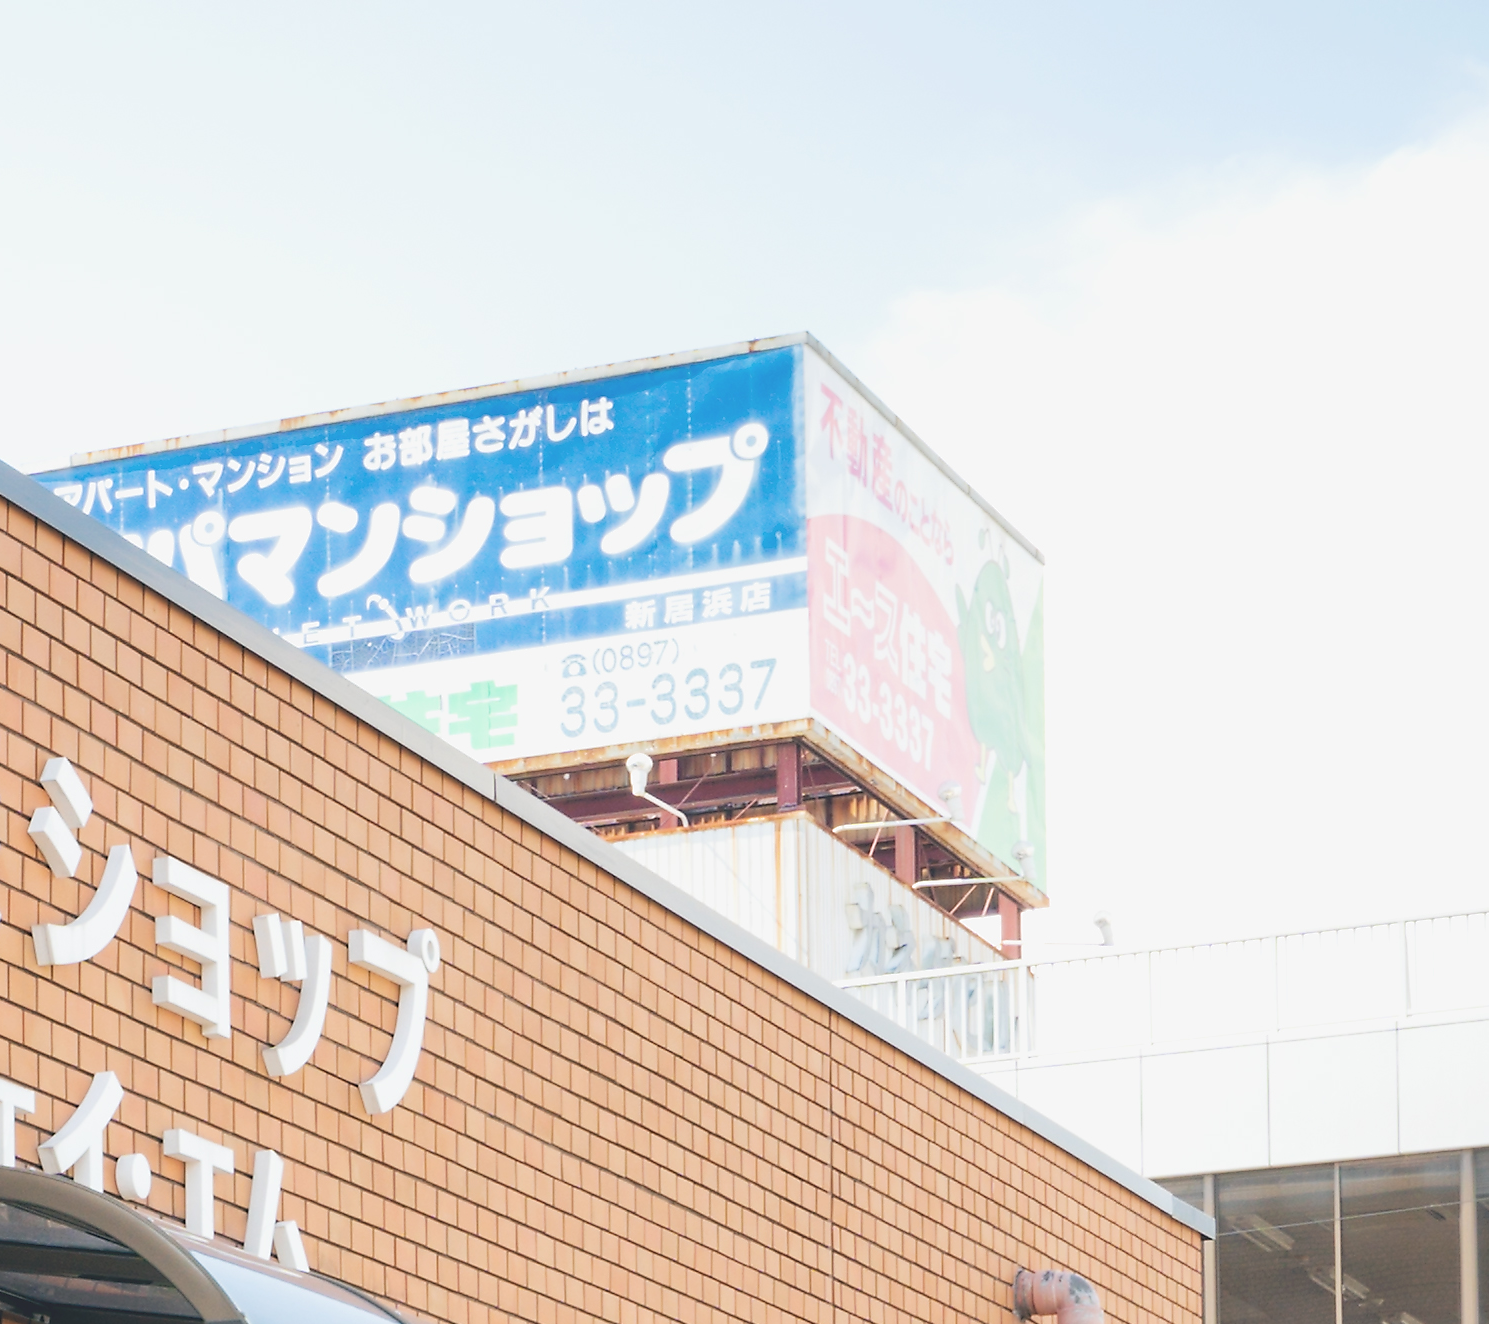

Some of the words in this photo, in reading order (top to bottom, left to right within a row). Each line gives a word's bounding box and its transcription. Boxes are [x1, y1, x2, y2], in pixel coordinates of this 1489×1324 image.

[363, 397, 615, 471] お部屋さがしは
[820, 381, 955, 566] 不動産のことなら
[624, 582, 772, 630] 新居浜店
[591, 638, 681, 676] (0897)
[559, 657, 778, 738] 33-3337
